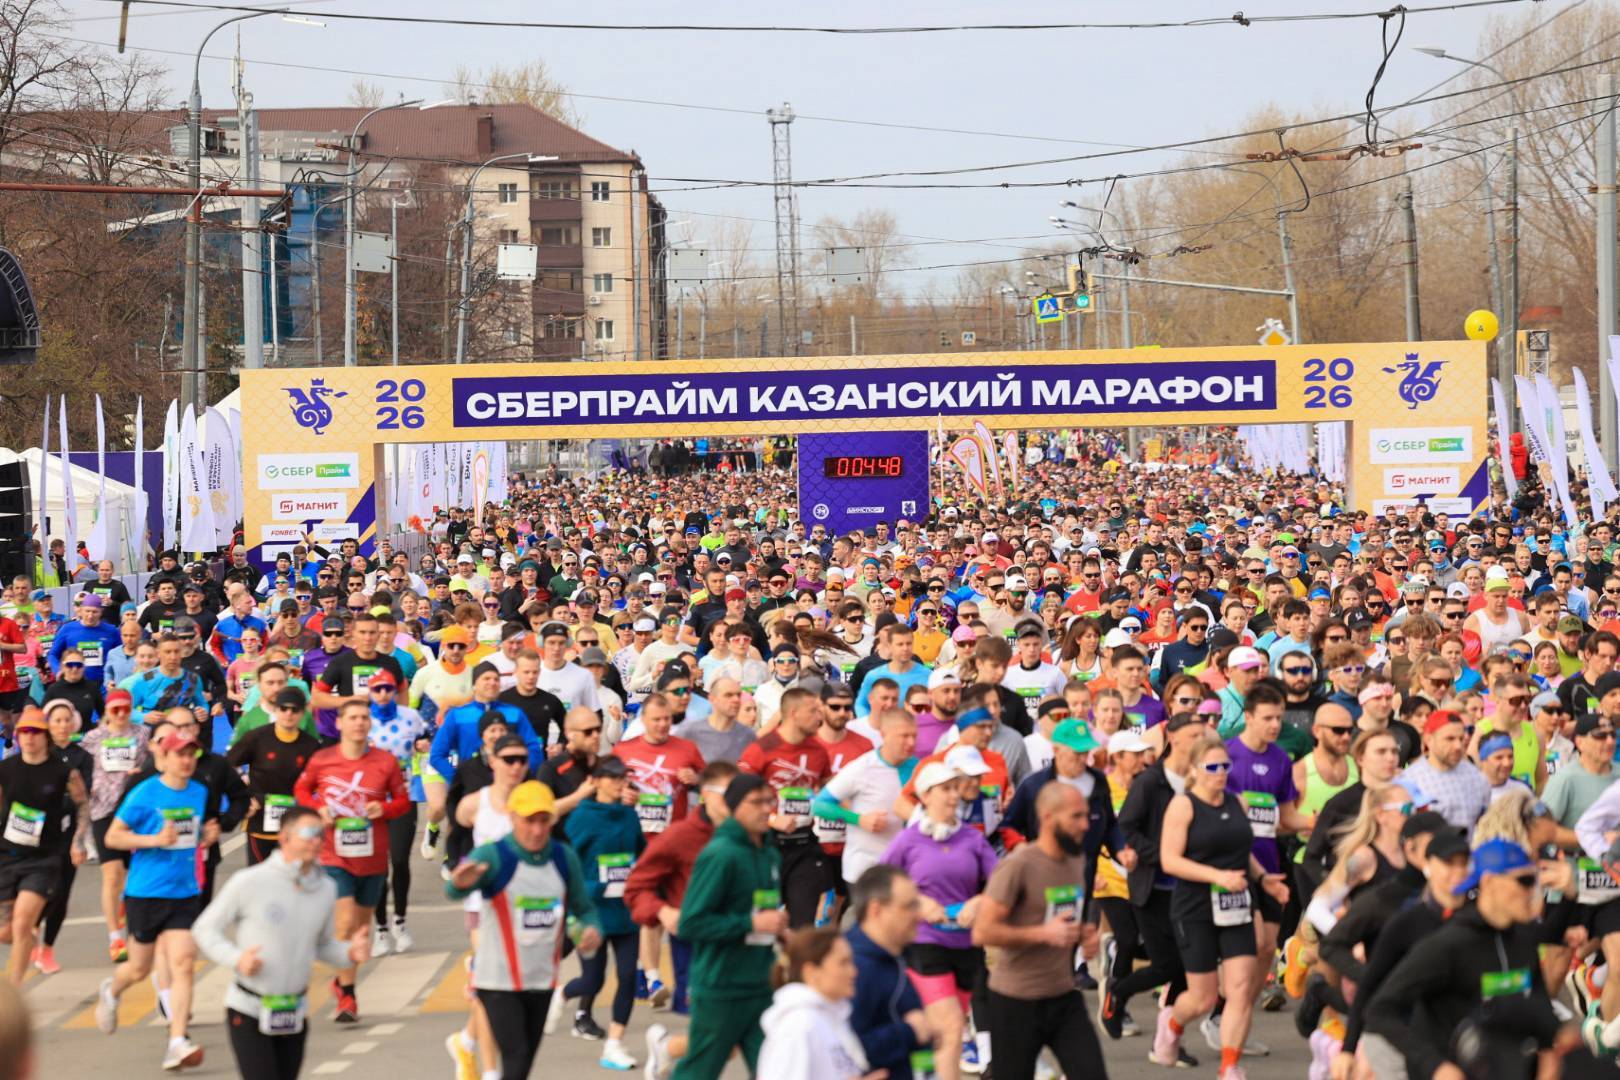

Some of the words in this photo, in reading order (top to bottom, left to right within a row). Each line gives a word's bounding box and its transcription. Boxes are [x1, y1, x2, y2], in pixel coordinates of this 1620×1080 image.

[1303, 357, 1354, 382] 20
[376, 379, 426, 402] 20
[466, 381, 739, 419] СБЕРПРАЙМ
[749, 372, 1021, 413] КАЗАНСКИЙ
[1032, 375, 1264, 406] МАРАФОН
[1304, 385, 1353, 408] 26
[377, 406, 425, 429] 26
[1393, 440, 1425, 450] СБЕР
[281, 466, 313, 476] СБЕР
[1408, 476, 1451, 485] МАГНИТ
[296, 502, 339, 510] МАГНИТ
